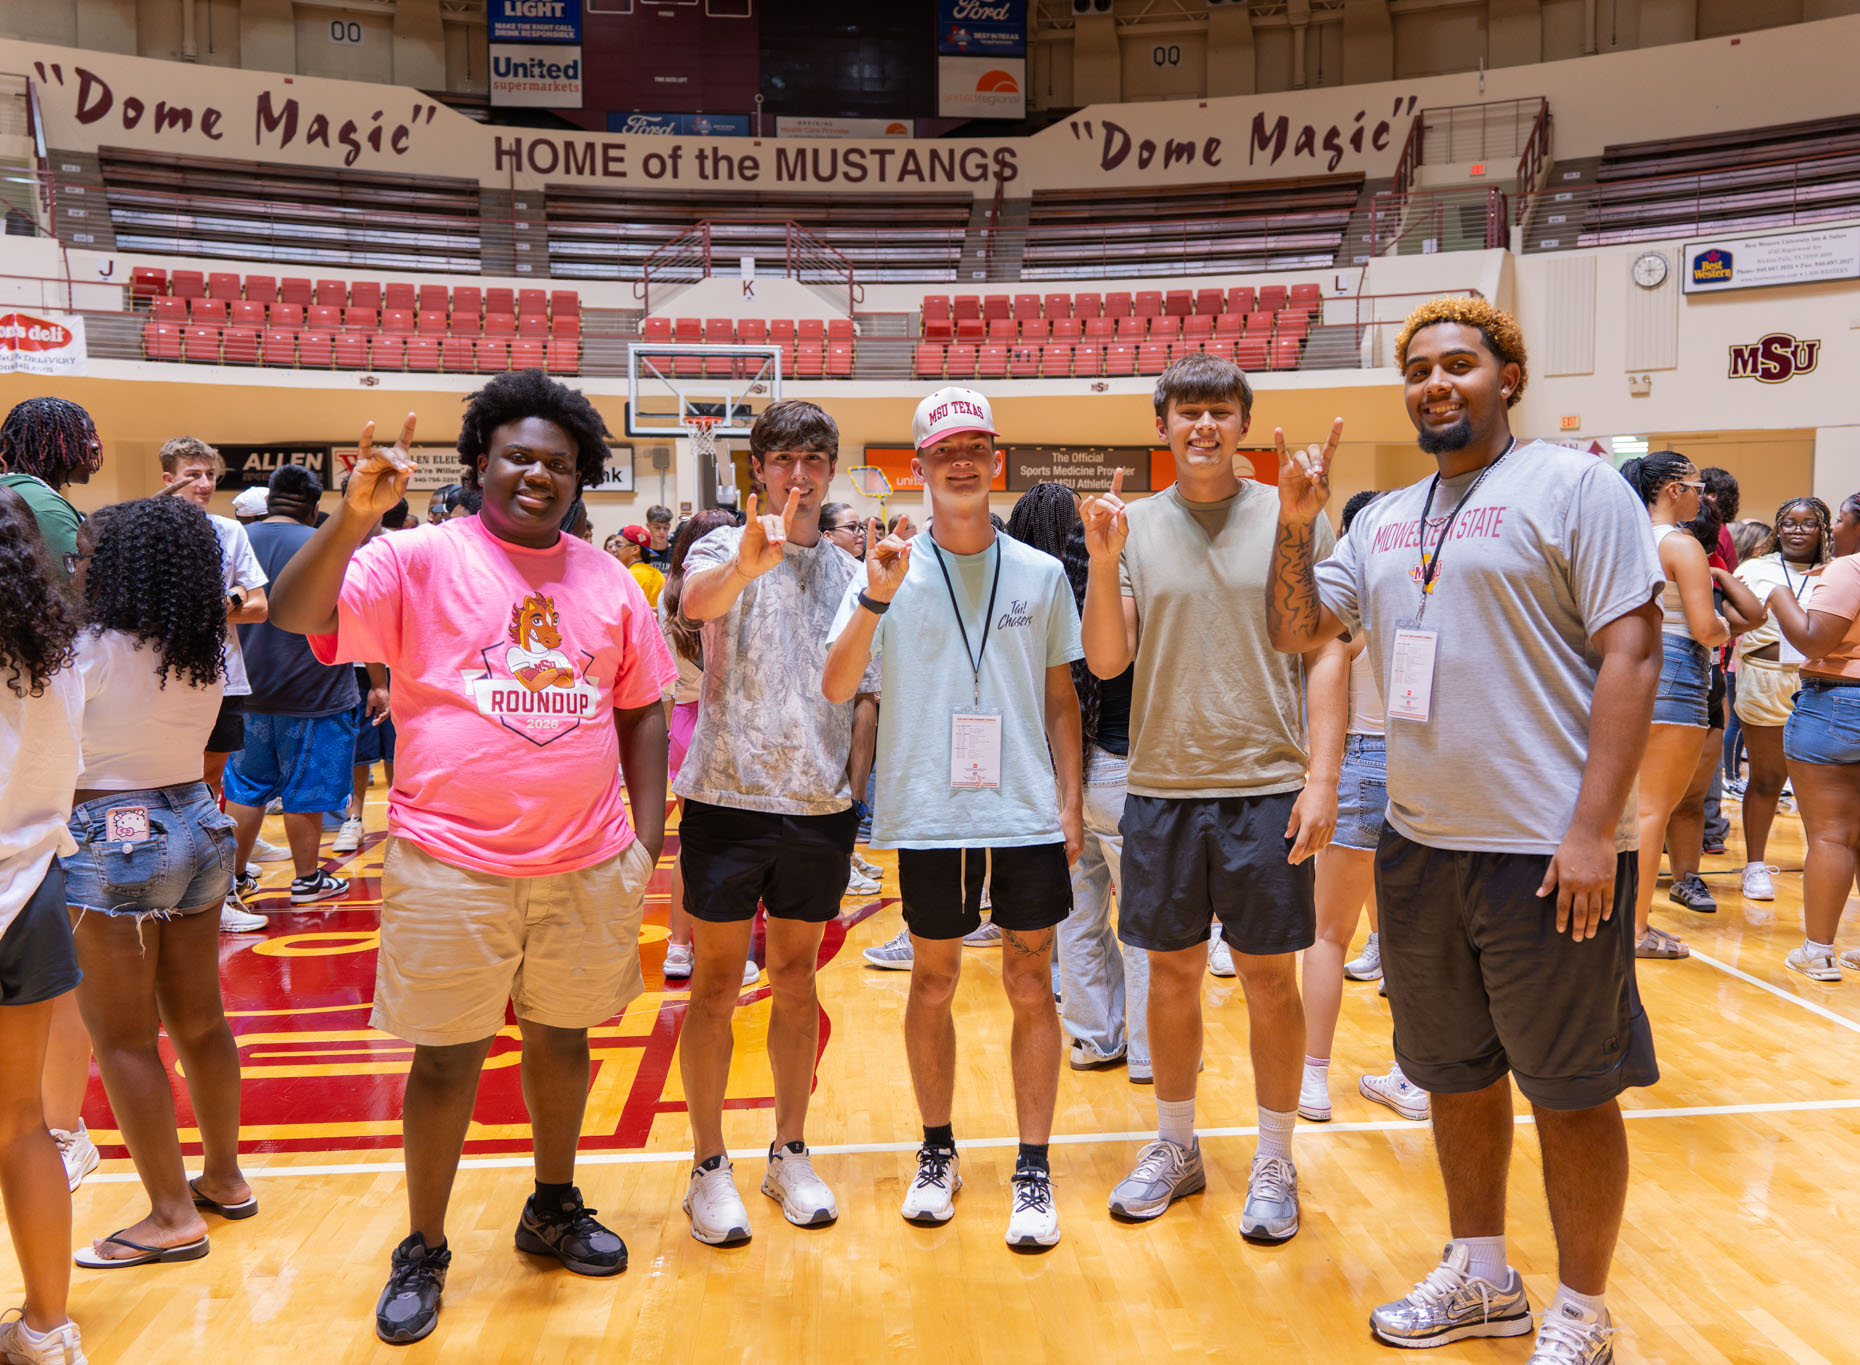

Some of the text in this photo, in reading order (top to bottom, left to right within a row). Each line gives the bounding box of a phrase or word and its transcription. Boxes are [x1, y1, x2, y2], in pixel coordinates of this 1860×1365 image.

[504, 1, 565, 17] LIGHT
[953, 0, 1010, 20] Ford
[493, 56, 579, 80] United
[494, 80, 580, 93] supermarkets
[494, 136, 1018, 183] HOME of the MUSTANGS
[99, 260, 114, 278] J
[1694, 268, 1732, 280] Western
[1701, 260, 1723, 272] Best
[743, 280, 754, 296] K
[1336, 275, 1347, 291] L
[0, 322, 64, 343] on's deli
[1728, 333, 1820, 383] MSU
[928, 400, 984, 427] MSU TEXAS
[242, 452, 323, 470] ALLEN
[410, 455, 429, 464] LEN
[1052, 452, 1104, 463] The Official
[1020, 465, 1051, 477] Sports
[1053, 466, 1094, 476] Medicine
[1079, 479, 1113, 489] Athletic
[1457, 506, 1507, 539] STATE
[1011, 599, 1027, 615] Tail
[998, 613, 1033, 630] Chasers
[491, 690, 588, 715] ROUNDUP
